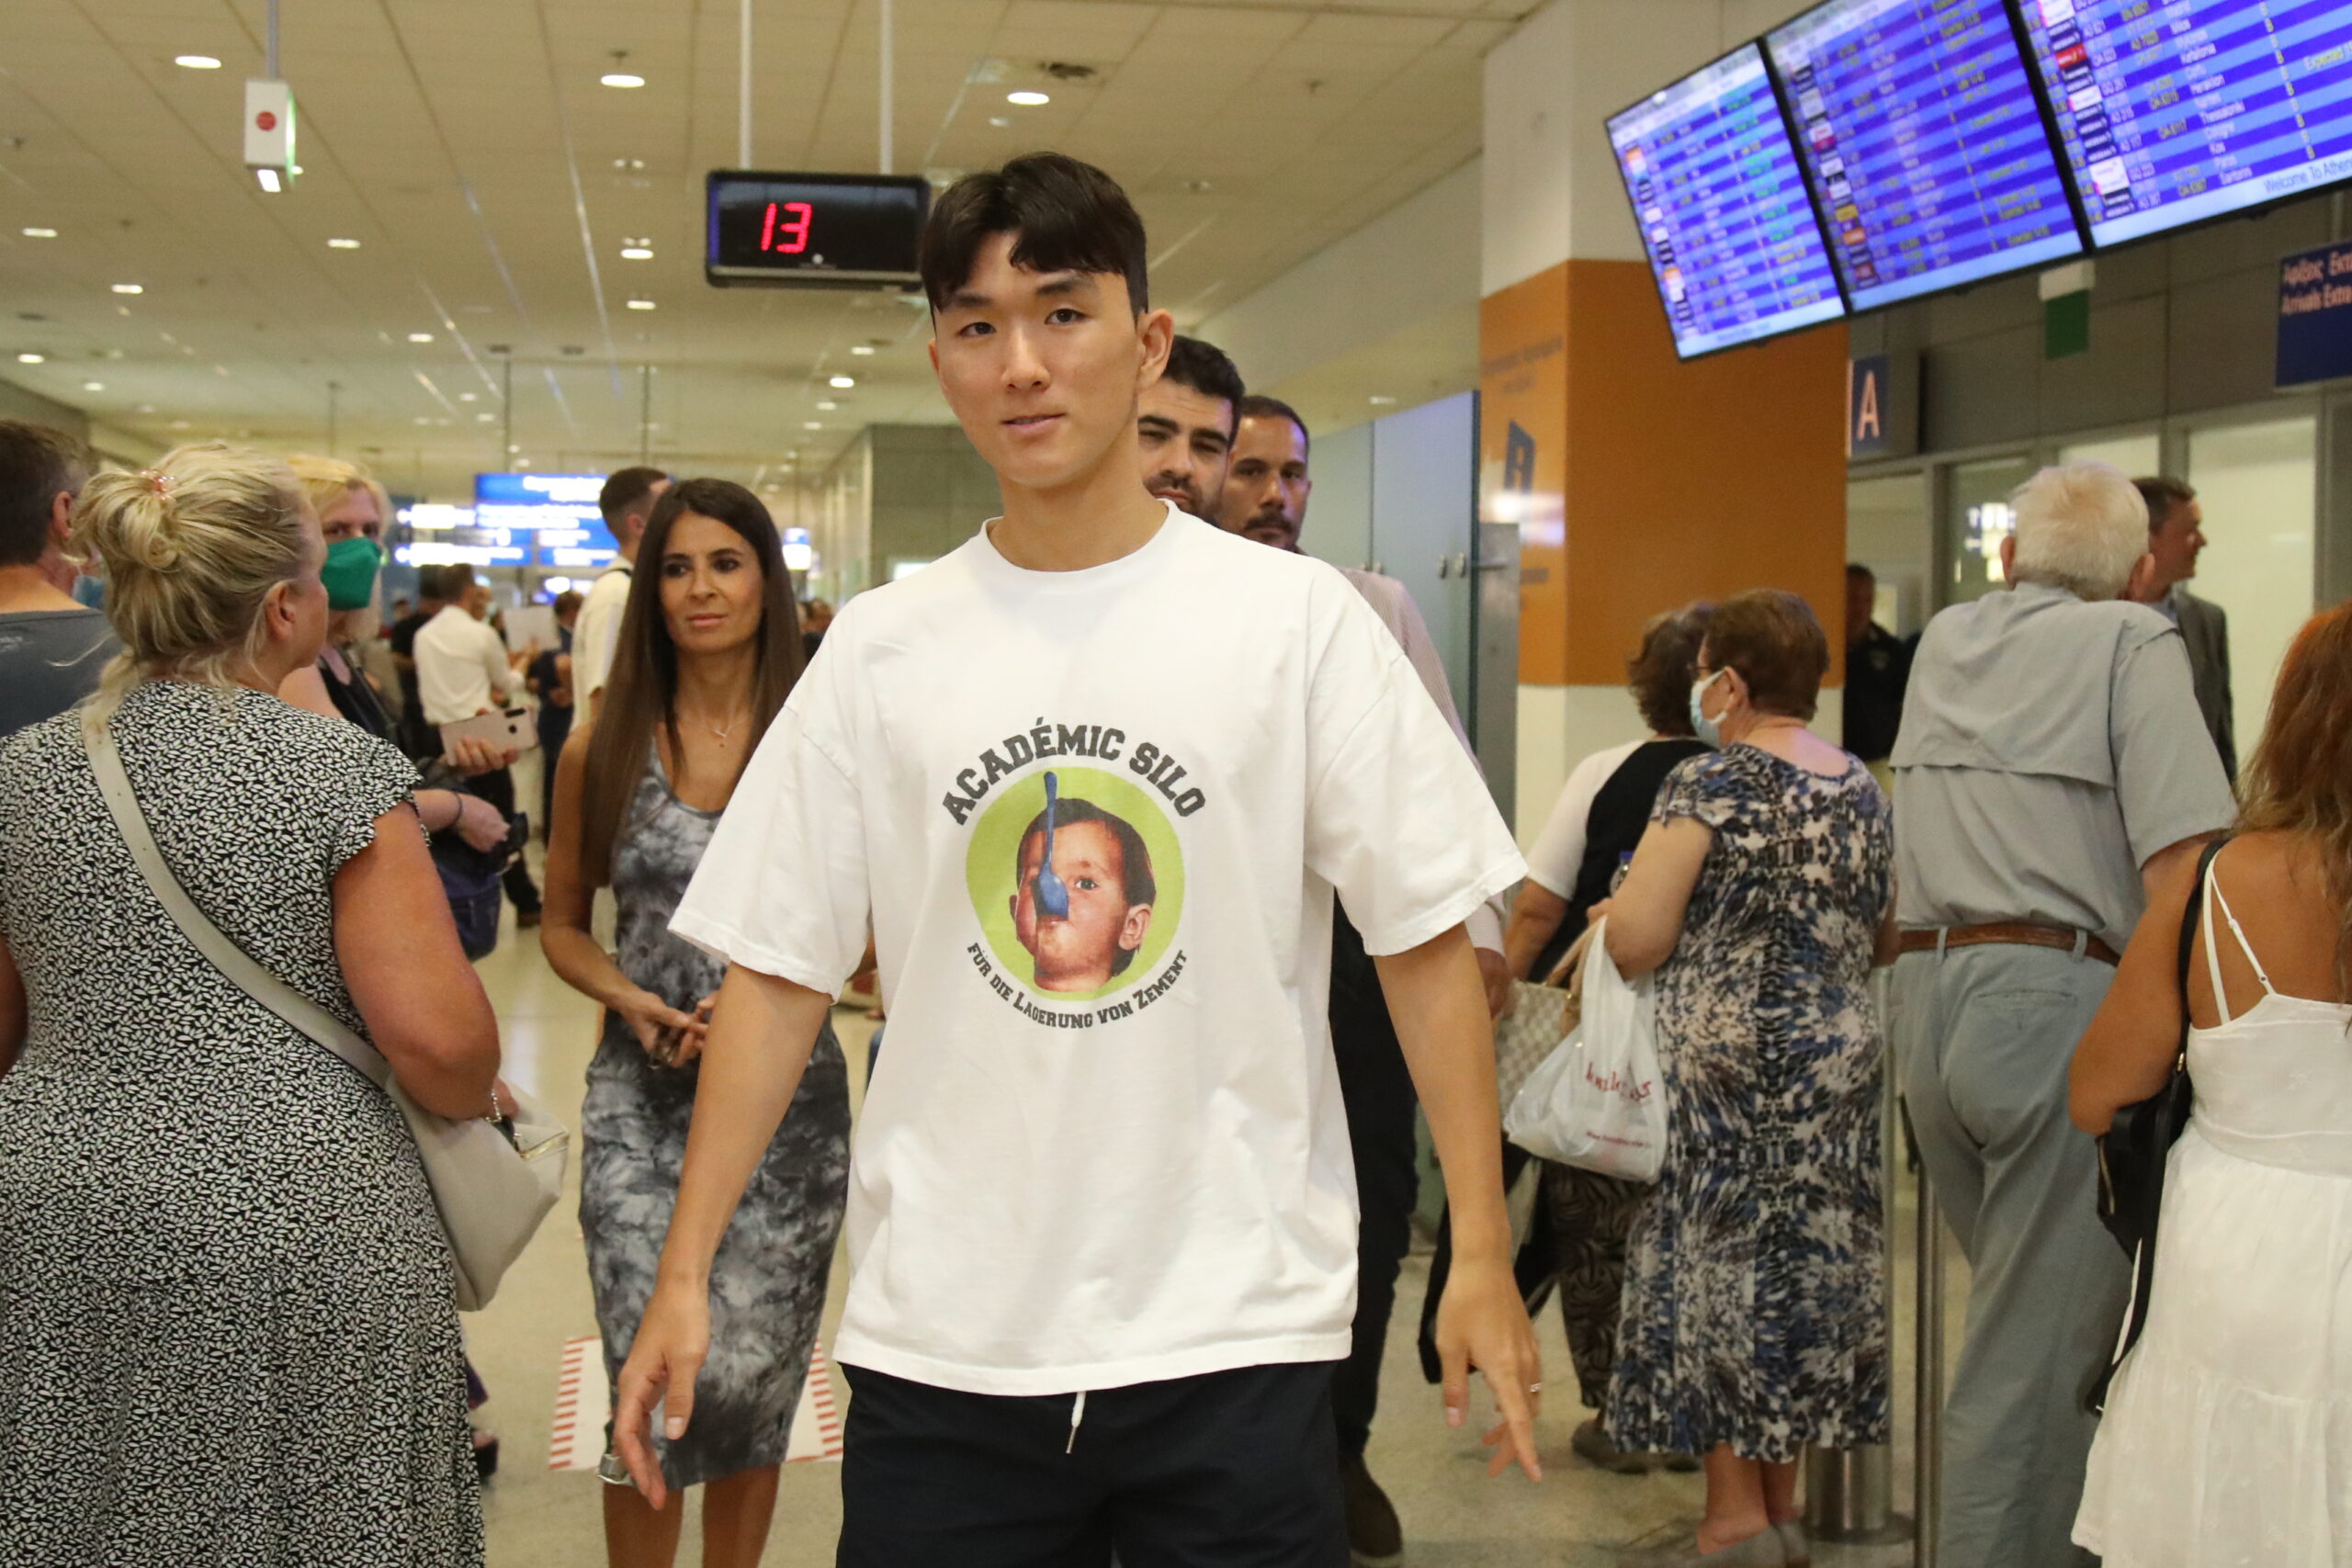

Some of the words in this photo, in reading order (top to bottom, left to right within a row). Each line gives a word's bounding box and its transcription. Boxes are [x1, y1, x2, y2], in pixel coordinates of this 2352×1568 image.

[760, 202, 813, 254] 13
[1857, 369, 1881, 440] A
[943, 716, 1125, 826] ACADÉMIC
[1129, 741, 1205, 817] SILO
[967, 942, 992, 976] FÜR
[989, 974, 1014, 1001] DIE
[1097, 1000, 1134, 1024] VON
